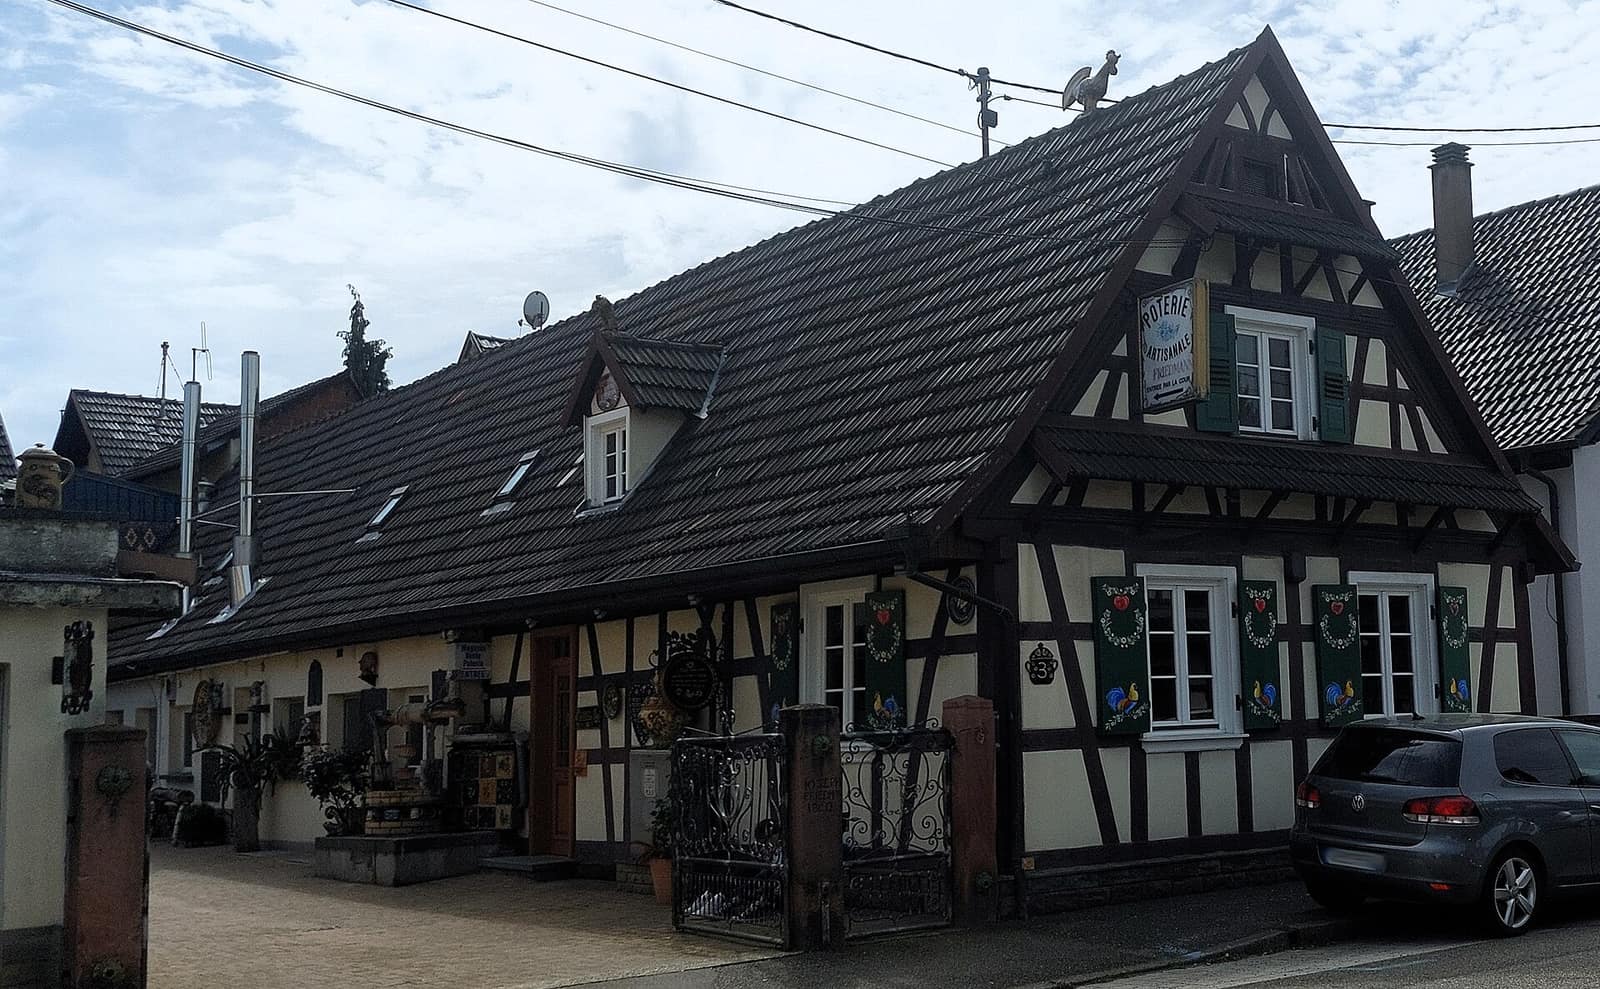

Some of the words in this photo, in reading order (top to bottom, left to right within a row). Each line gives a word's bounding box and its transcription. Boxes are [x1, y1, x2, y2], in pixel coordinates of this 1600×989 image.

[1142, 295, 1191, 329] POTERIE
[1146, 333, 1191, 363] ARTISANALE
[1172, 378, 1178, 387] LA
[1179, 375, 1190, 384] COUR
[1037, 661, 1048, 679] 3
